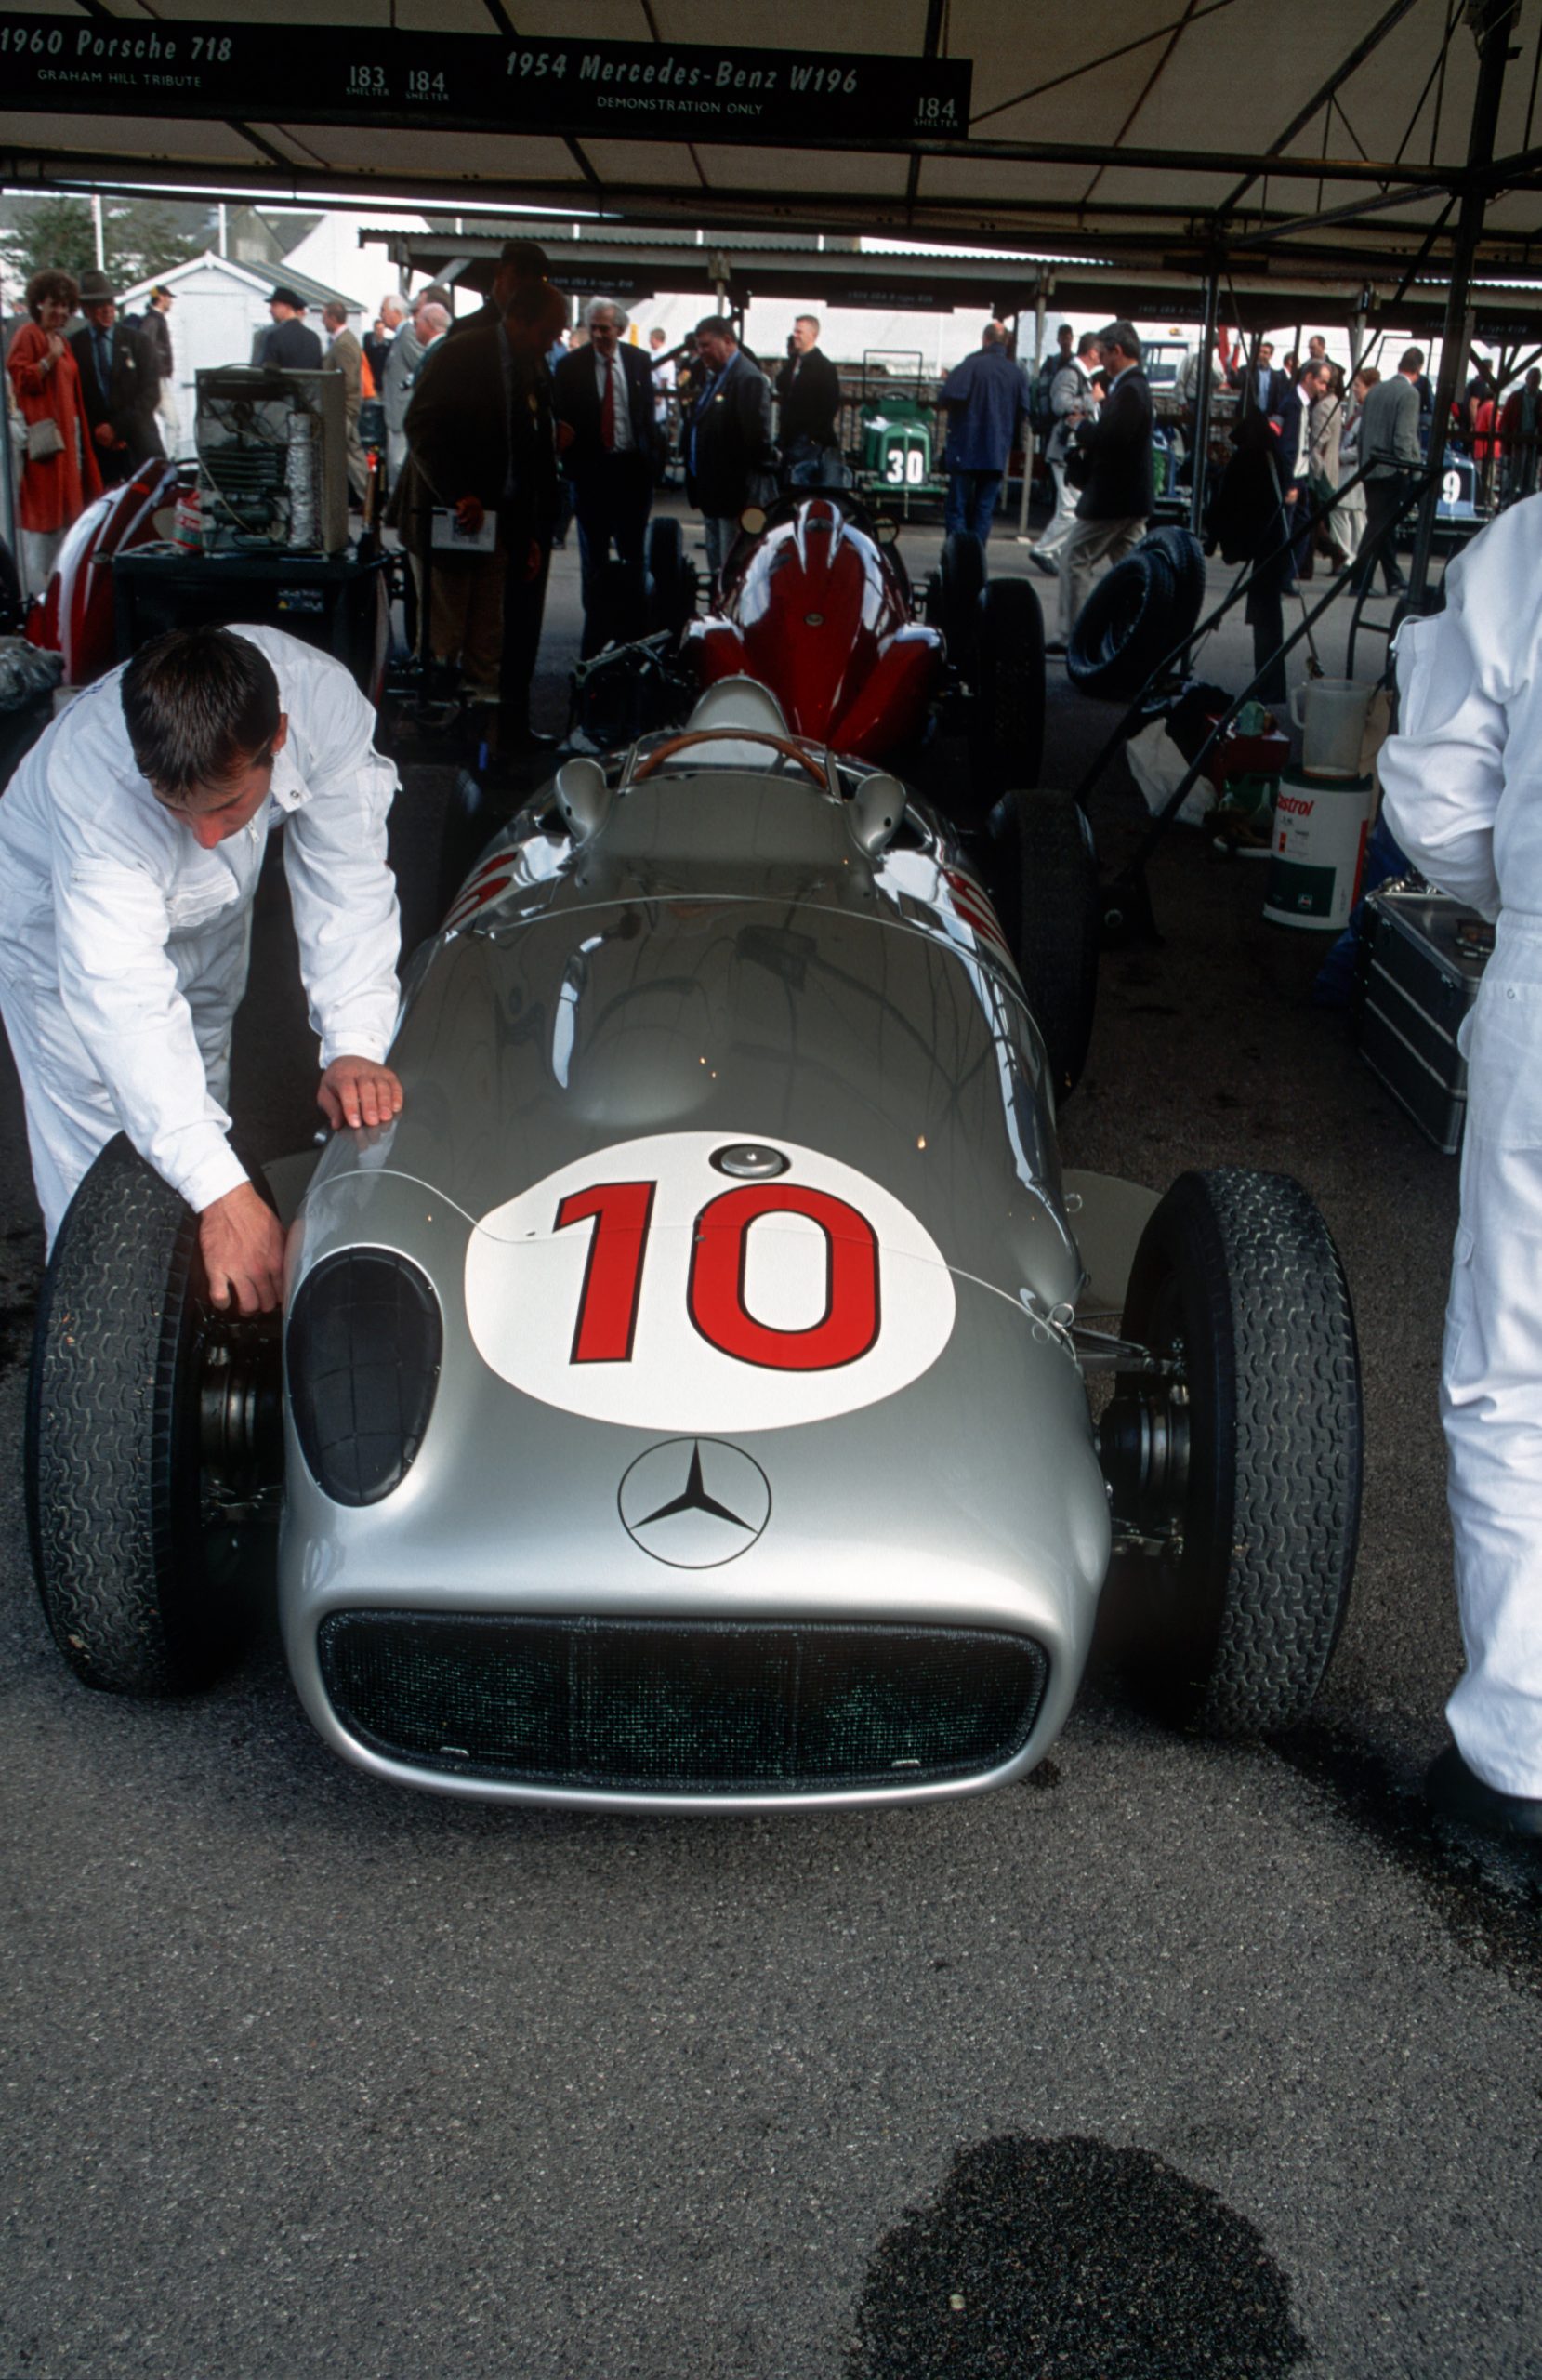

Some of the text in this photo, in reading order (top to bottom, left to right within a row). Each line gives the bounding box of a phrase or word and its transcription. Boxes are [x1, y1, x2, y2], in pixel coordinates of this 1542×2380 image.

[0, 27, 232, 61] 1960 Porsche 718
[37, 69, 202, 87] GRAHAM HILL TRIBUTE
[350, 65, 386, 87] 183
[409, 70, 445, 93] 184
[507, 51, 858, 93] 1954 Mercedes-Benz W196
[346, 86, 390, 97] SHELTER
[405, 91, 450, 101] SHELTER
[597, 96, 764, 115] DEMONSTRATION ONLY
[918, 97, 956, 119] 184
[913, 118, 959, 127] SHELTER
[887, 449, 924, 484] 30
[1442, 469, 1462, 505] 9
[1278, 792, 1315, 816] astrol
[552, 1180, 881, 1372] 10
